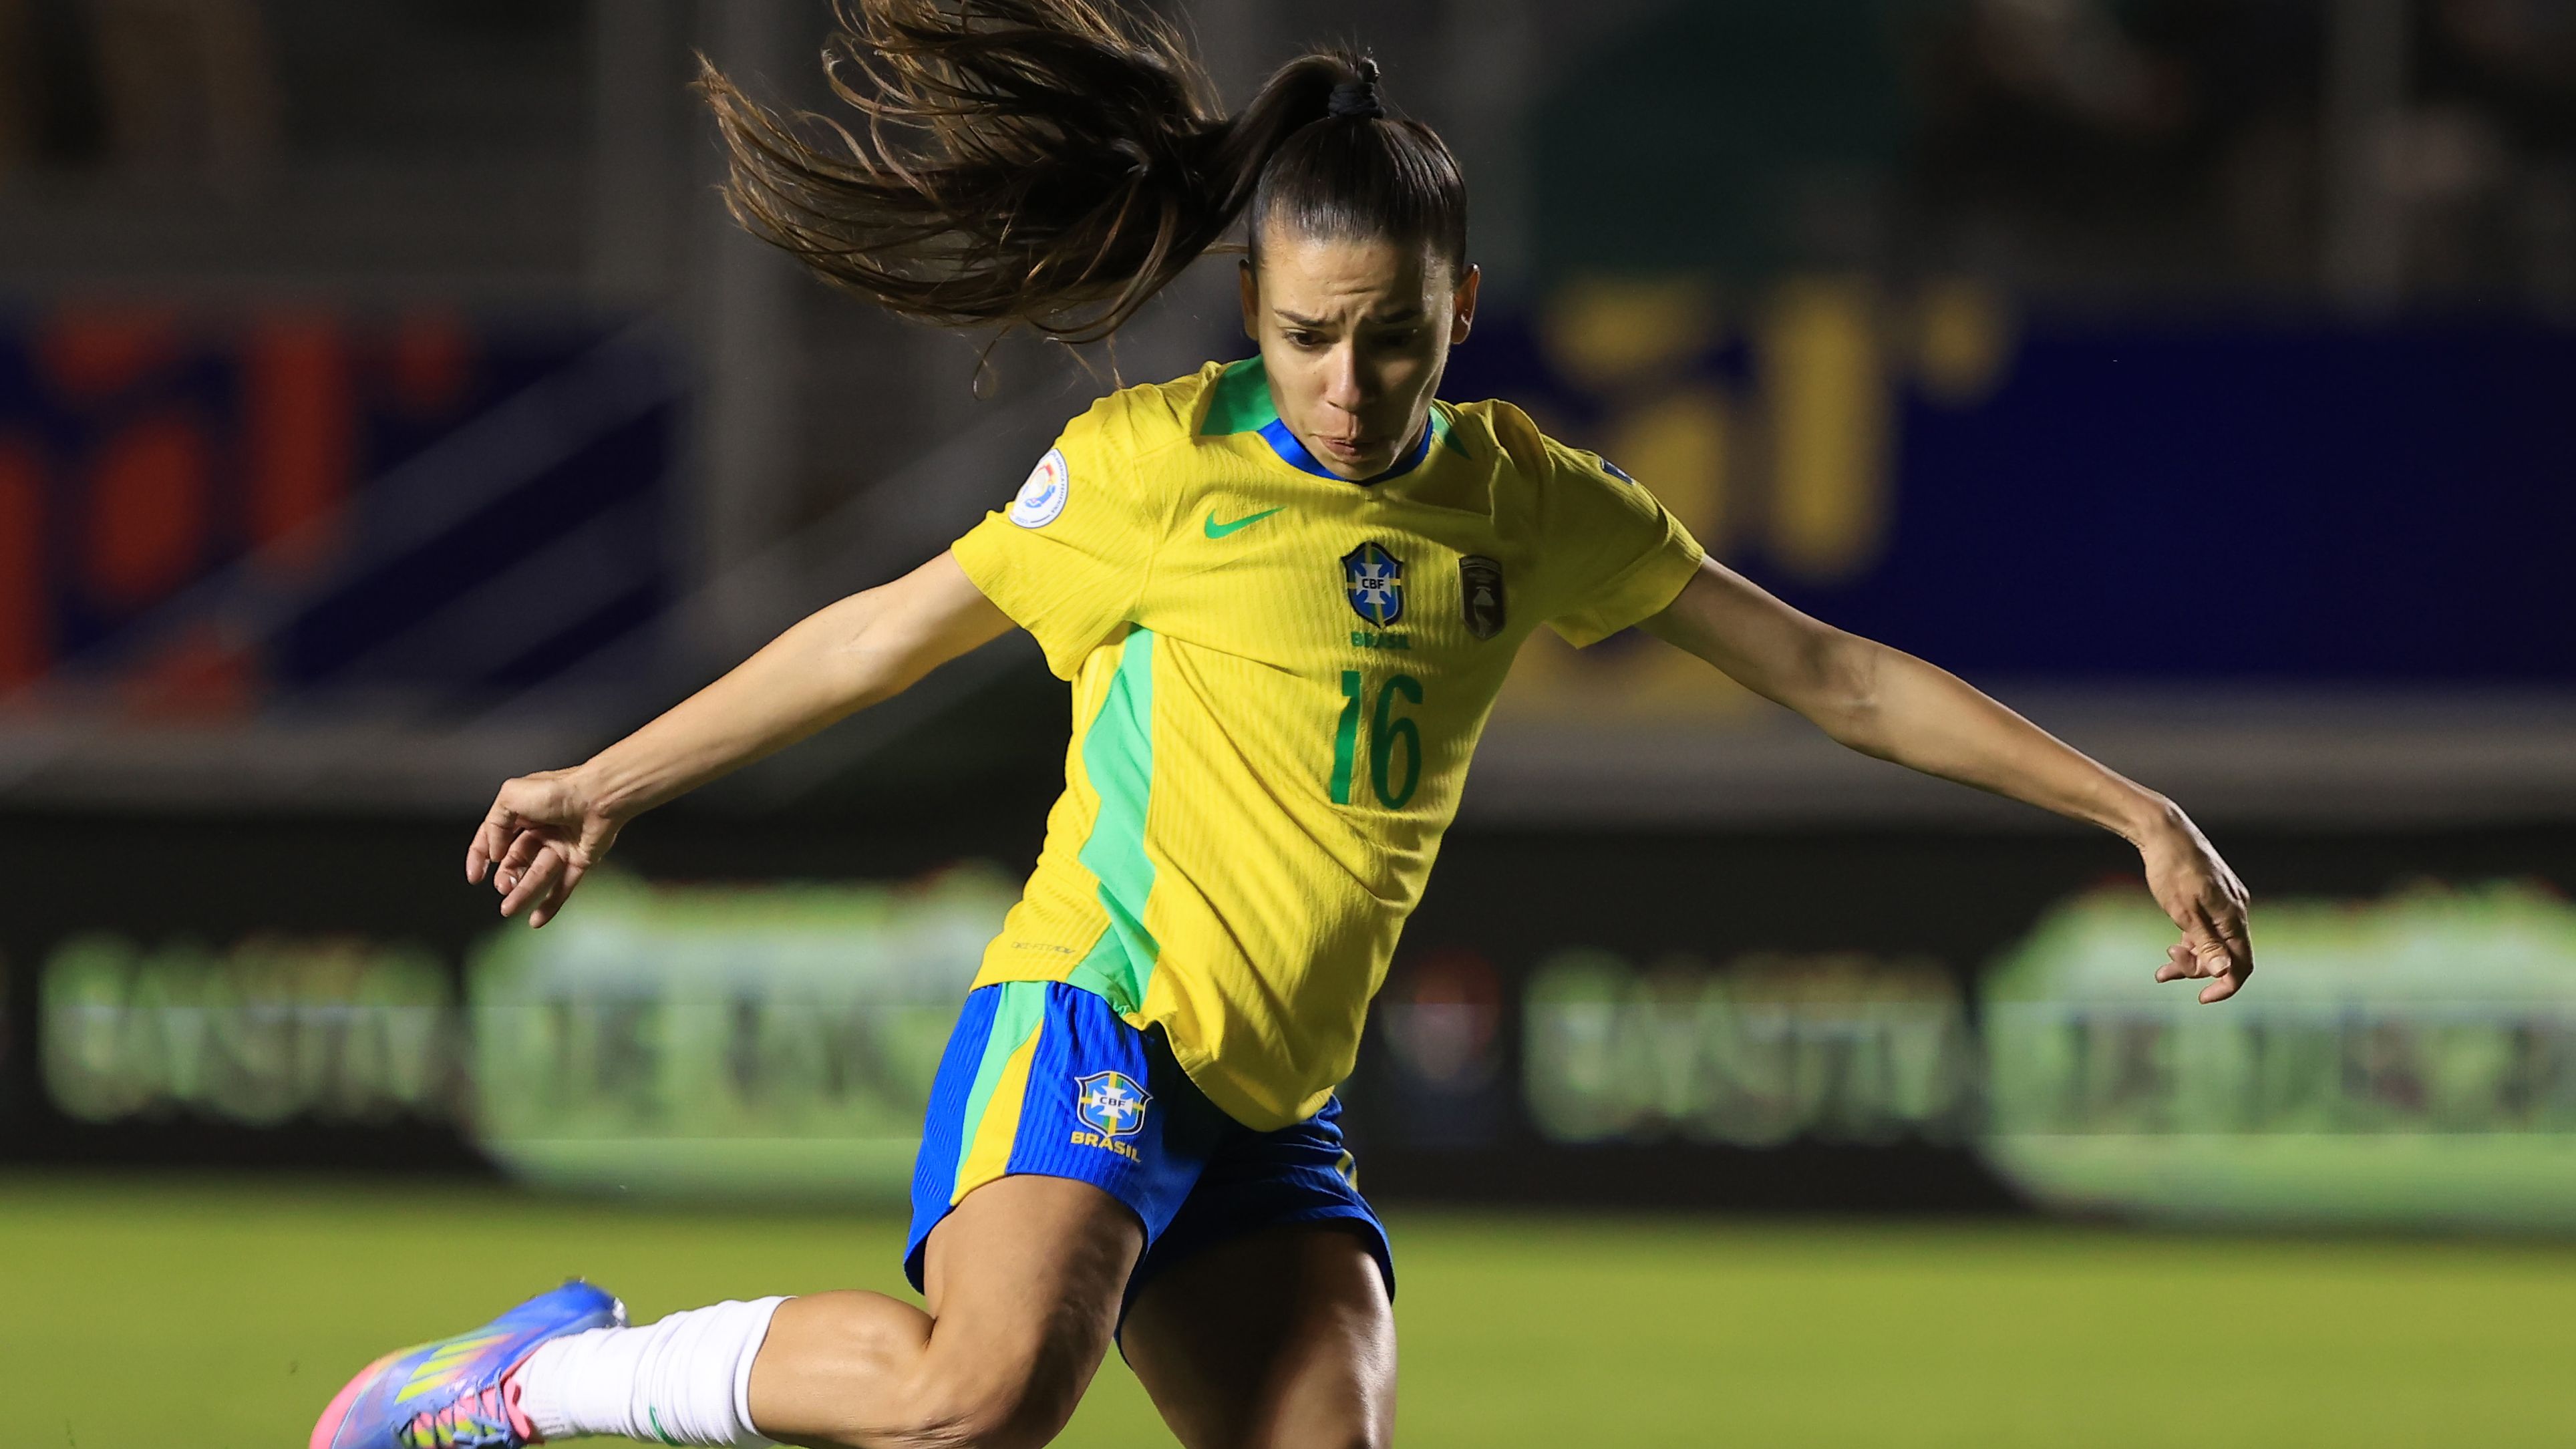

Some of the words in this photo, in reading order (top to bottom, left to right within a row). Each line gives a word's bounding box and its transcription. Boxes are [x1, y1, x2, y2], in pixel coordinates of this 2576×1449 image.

[1361, 579, 1384, 589] CBF
[1329, 670, 1423, 810] 16
[1100, 1096, 1126, 1107] CBF
[1070, 1131, 1142, 1163] BRASIL
